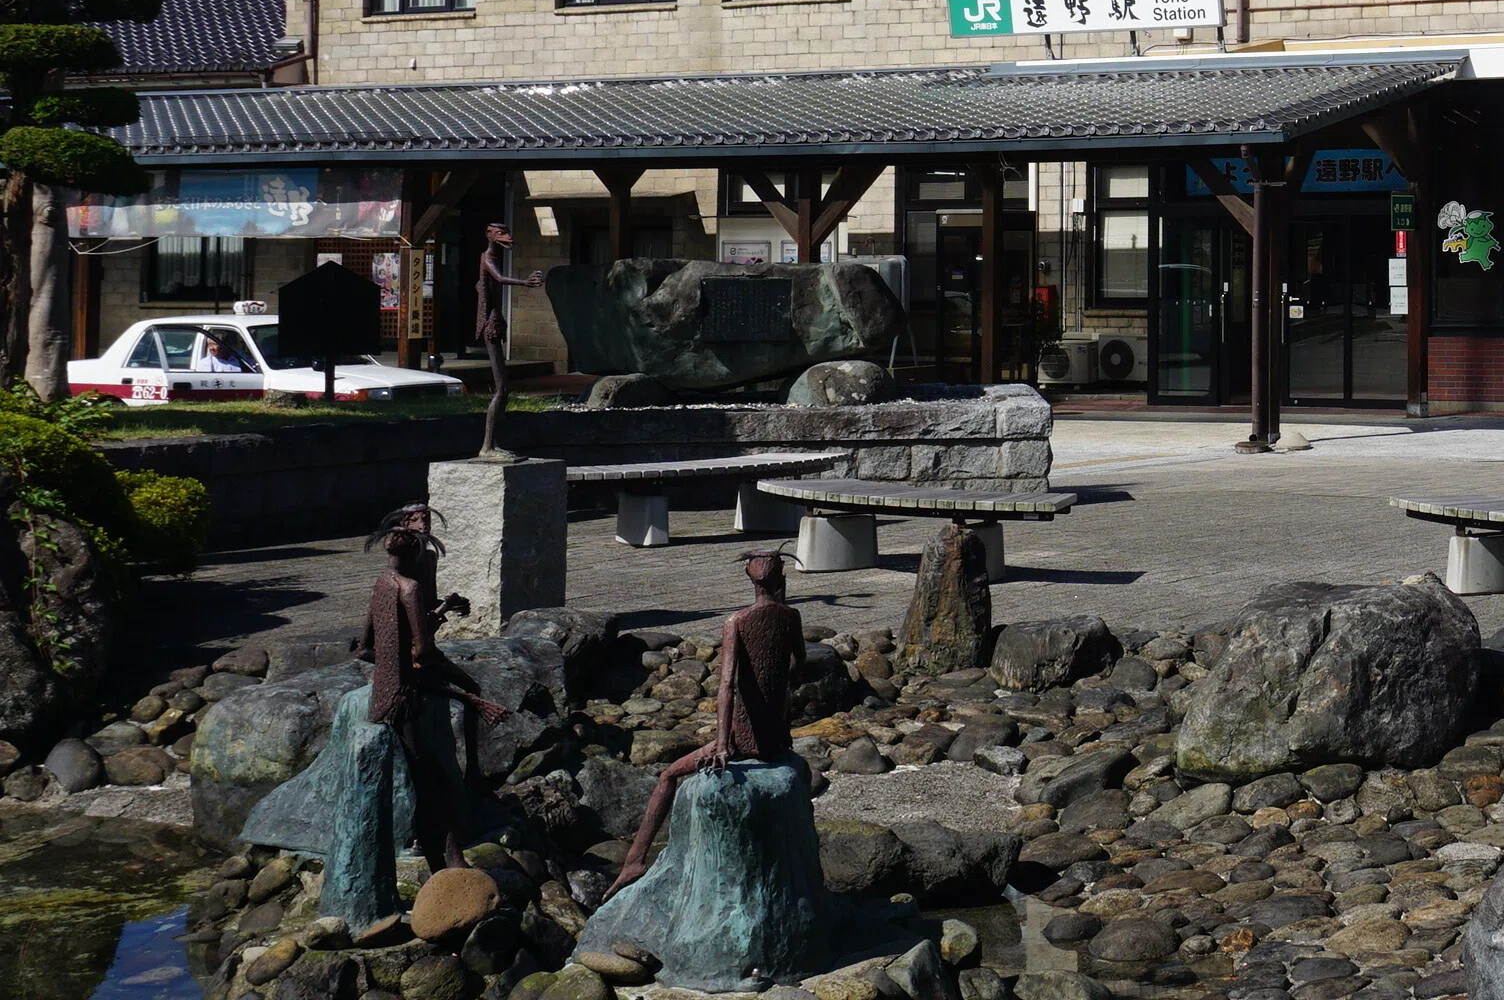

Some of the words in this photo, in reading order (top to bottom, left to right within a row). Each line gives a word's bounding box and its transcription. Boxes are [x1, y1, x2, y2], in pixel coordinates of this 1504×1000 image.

[1153, 6, 1207, 22] Station
[970, 21, 999, 31] JR東日本
[411, 256, 421, 334] タクシー乗場
